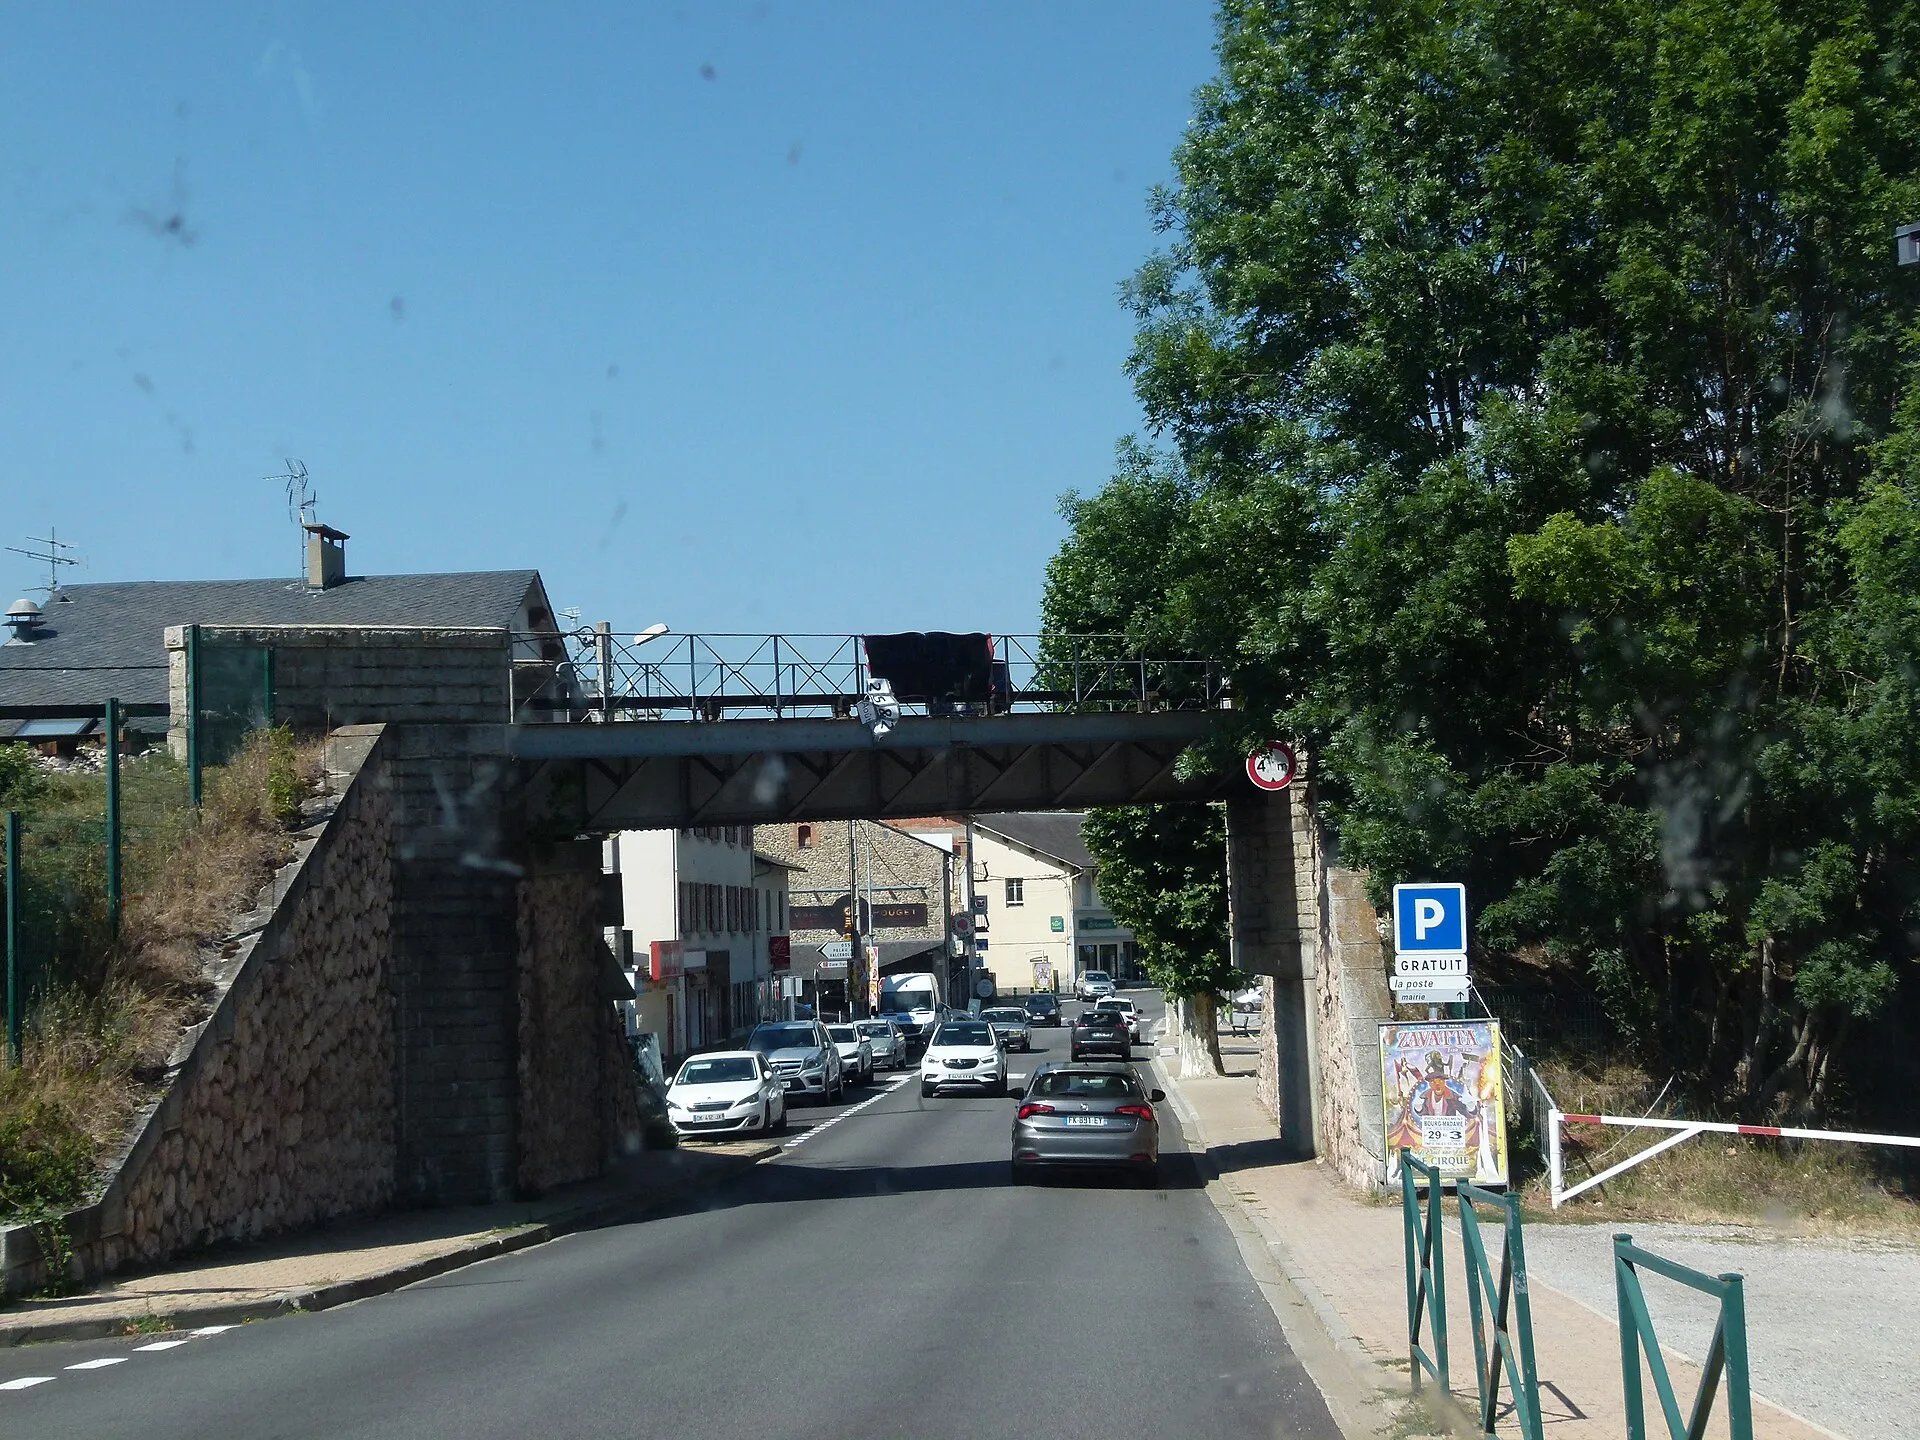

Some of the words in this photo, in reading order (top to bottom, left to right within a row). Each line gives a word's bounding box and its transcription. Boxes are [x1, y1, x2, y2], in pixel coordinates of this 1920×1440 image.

[1414, 898, 1445, 940] P
[1401, 959, 1462, 971] GRATUIT
[1394, 979, 1403, 988] la
[1406, 980, 1434, 990] poste
[1401, 992, 1426, 1001] mairie
[1397, 1030, 1479, 1048] ZAVATTA
[1428, 1130, 1442, 1140] 29
[1449, 1130, 1463, 1140] 3
[1430, 1156, 1470, 1166] CIRQUE
